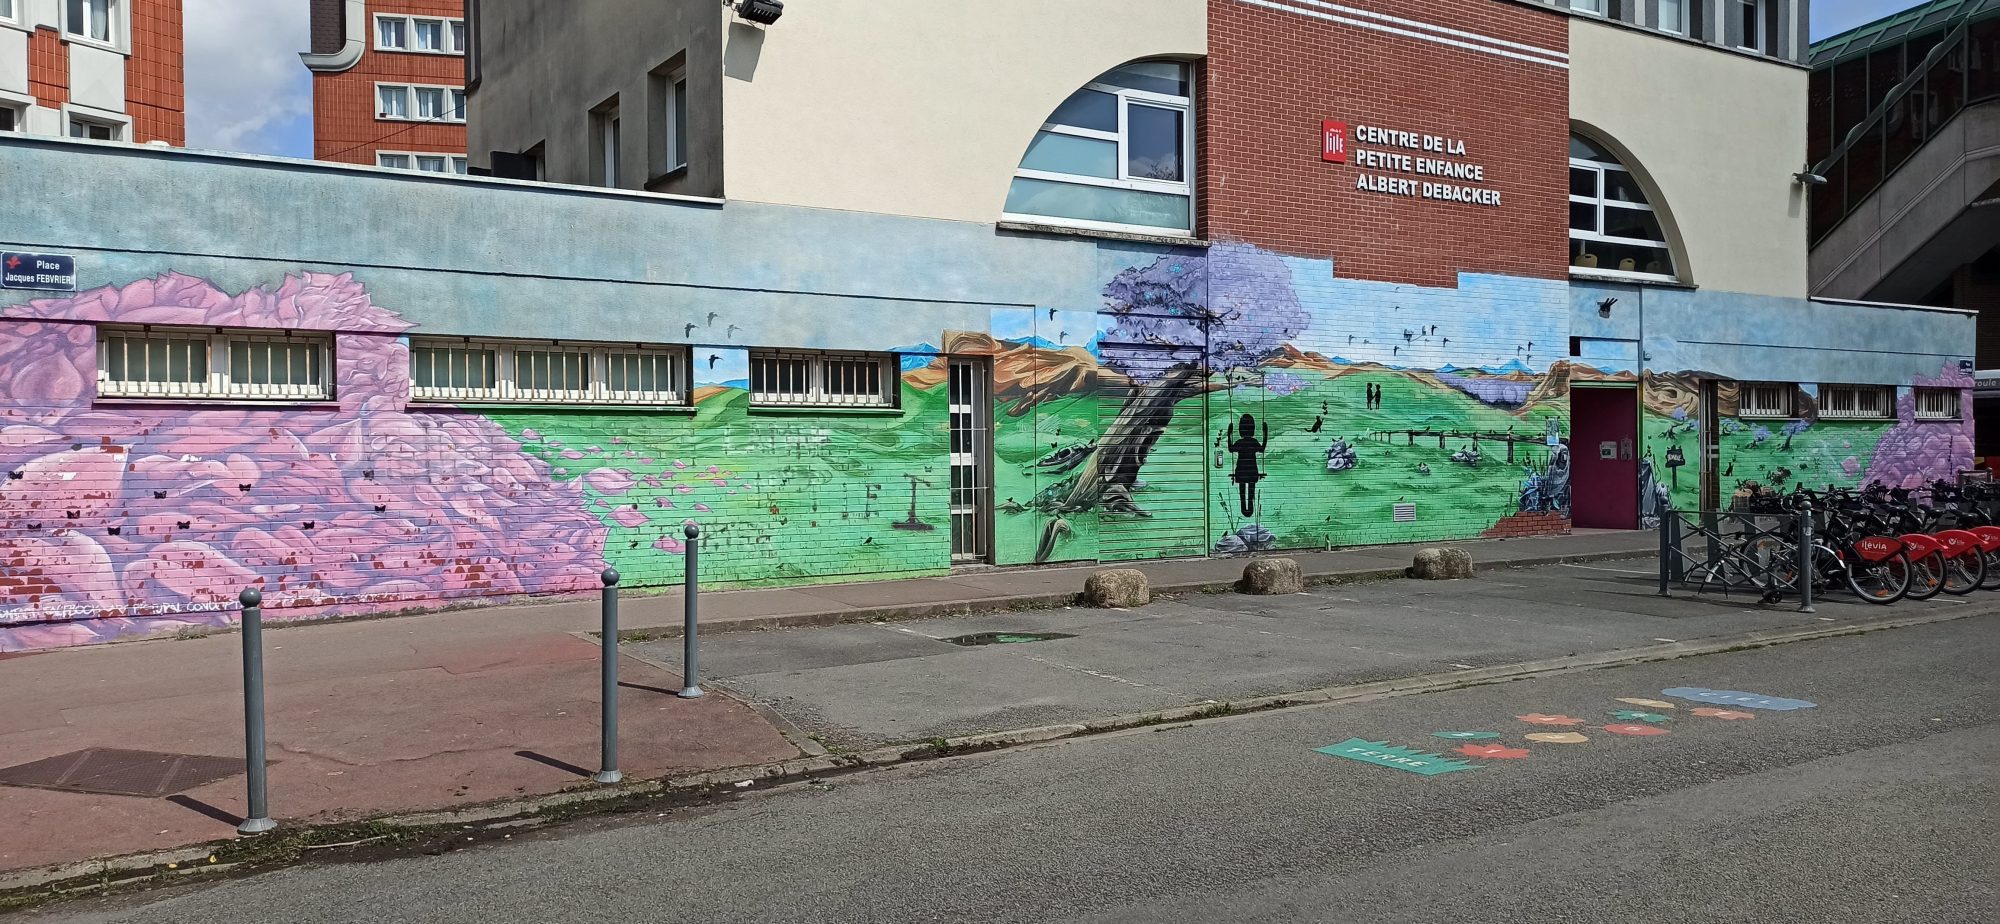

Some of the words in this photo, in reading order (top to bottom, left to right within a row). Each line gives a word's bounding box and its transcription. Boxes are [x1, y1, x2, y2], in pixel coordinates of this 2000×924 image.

[1356, 125, 1419, 149] CENTRE
[1423, 135, 1443, 153] DE
[1447, 139, 1467, 156] LA
[1356, 149, 1412, 171] PETITE
[1416, 157, 1484, 181] ENFANCE
[1356, 173, 1419, 196] ALBERT
[1423, 183, 1502, 206] DEBACKER
[36, 260, 60, 270] Place
[5, 272, 35, 284] Jacques
[36, 274, 71, 285] FEBVRIER
[1347, 747, 1430, 767] TERRE
